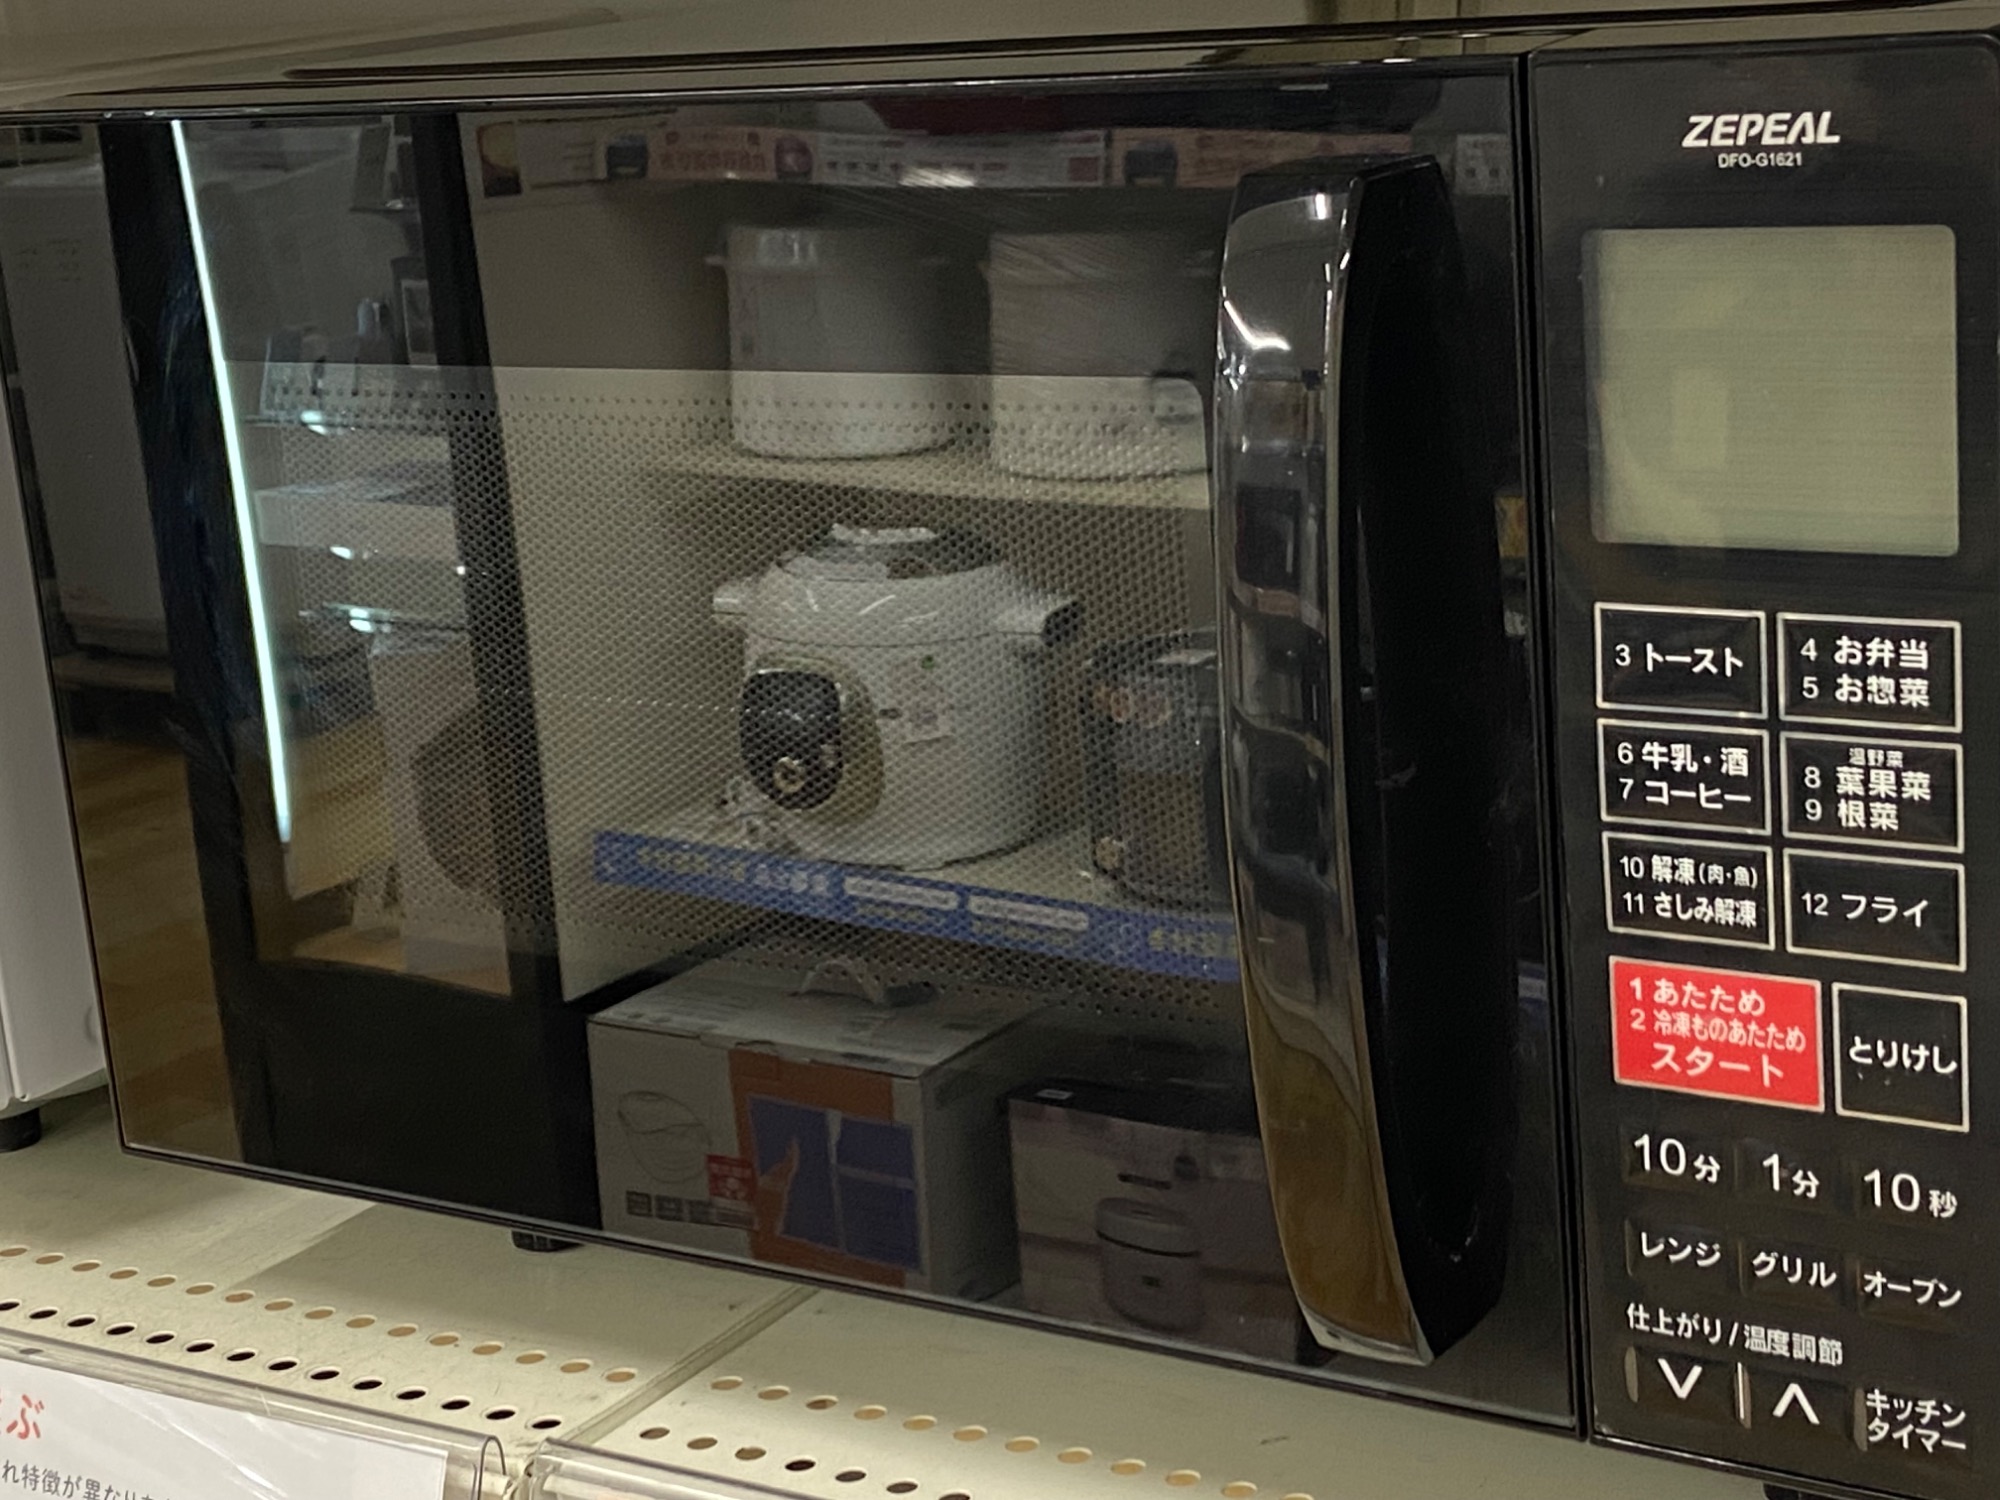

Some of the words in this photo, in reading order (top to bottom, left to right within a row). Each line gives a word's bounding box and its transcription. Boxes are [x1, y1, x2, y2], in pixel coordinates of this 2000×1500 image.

[1682, 111, 1841, 148] ZEPEAL
[1718, 152, 1802, 168] DFO-G1621
[1615, 644, 1631, 665] 3
[1644, 644, 1744, 678] トースト
[1800, 638, 1818, 661] 4
[1834, 636, 1930, 671] お弁当
[1802, 677, 1817, 699] 5
[1835, 675, 1930, 707] お惣菜
[1618, 743, 1633, 765] 6
[1619, 779, 1632, 800] 7
[1644, 782, 1751, 809] コーヒー
[1805, 767, 1820, 788] 8
[1836, 766, 1932, 801] 葉果菜
[1806, 799, 1821, 821] 9
[1837, 801, 1899, 831] 根菜
[1620, 857, 1644, 879] 10
[1623, 894, 1644, 914] 11
[1653, 892, 1758, 928] さしみ解凍
[1801, 894, 1828, 915] 12
[1842, 894, 1930, 928] フライ
[1630, 979, 1642, 999] 1
[1653, 980, 1765, 1014] あたため
[1631, 1011, 1645, 1030] 2
[1654, 1011, 1806, 1051] 冷凍ものあたため
[1652, 1045, 1784, 1087] スタート
[1848, 1036, 1959, 1073] とりけし
[1641, 1232, 1721, 1266] レンジ
[1752, 1251, 1837, 1288] グリル
[1863, 1271, 1962, 1308] オープン
[1866, 1389, 1966, 1427] キッチン
[1867, 1421, 1967, 1452] タイマー
